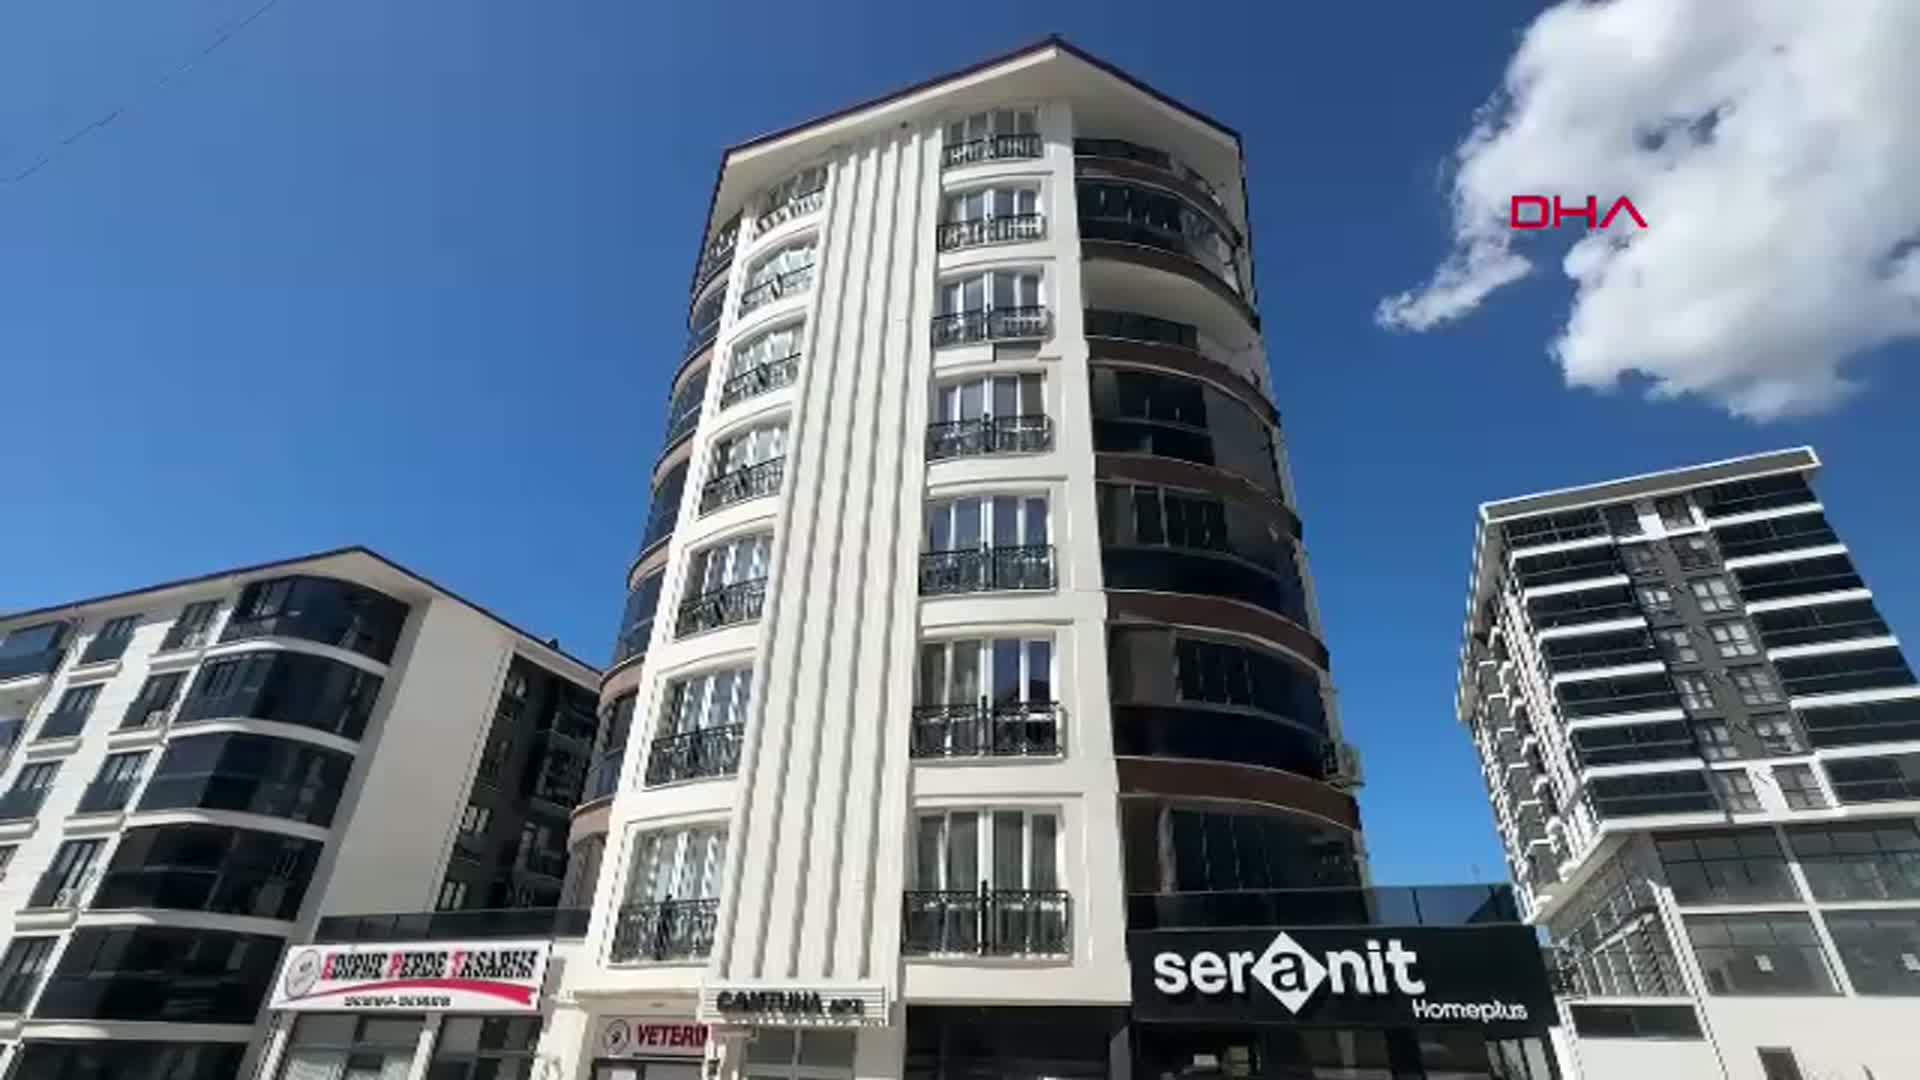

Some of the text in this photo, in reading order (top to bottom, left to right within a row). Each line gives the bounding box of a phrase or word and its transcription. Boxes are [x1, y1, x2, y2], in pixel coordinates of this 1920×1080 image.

[387, 950, 447, 977] PERDE
[1153, 934, 1426, 1003] seranit
[1411, 998, 1528, 1023] Homeplus
